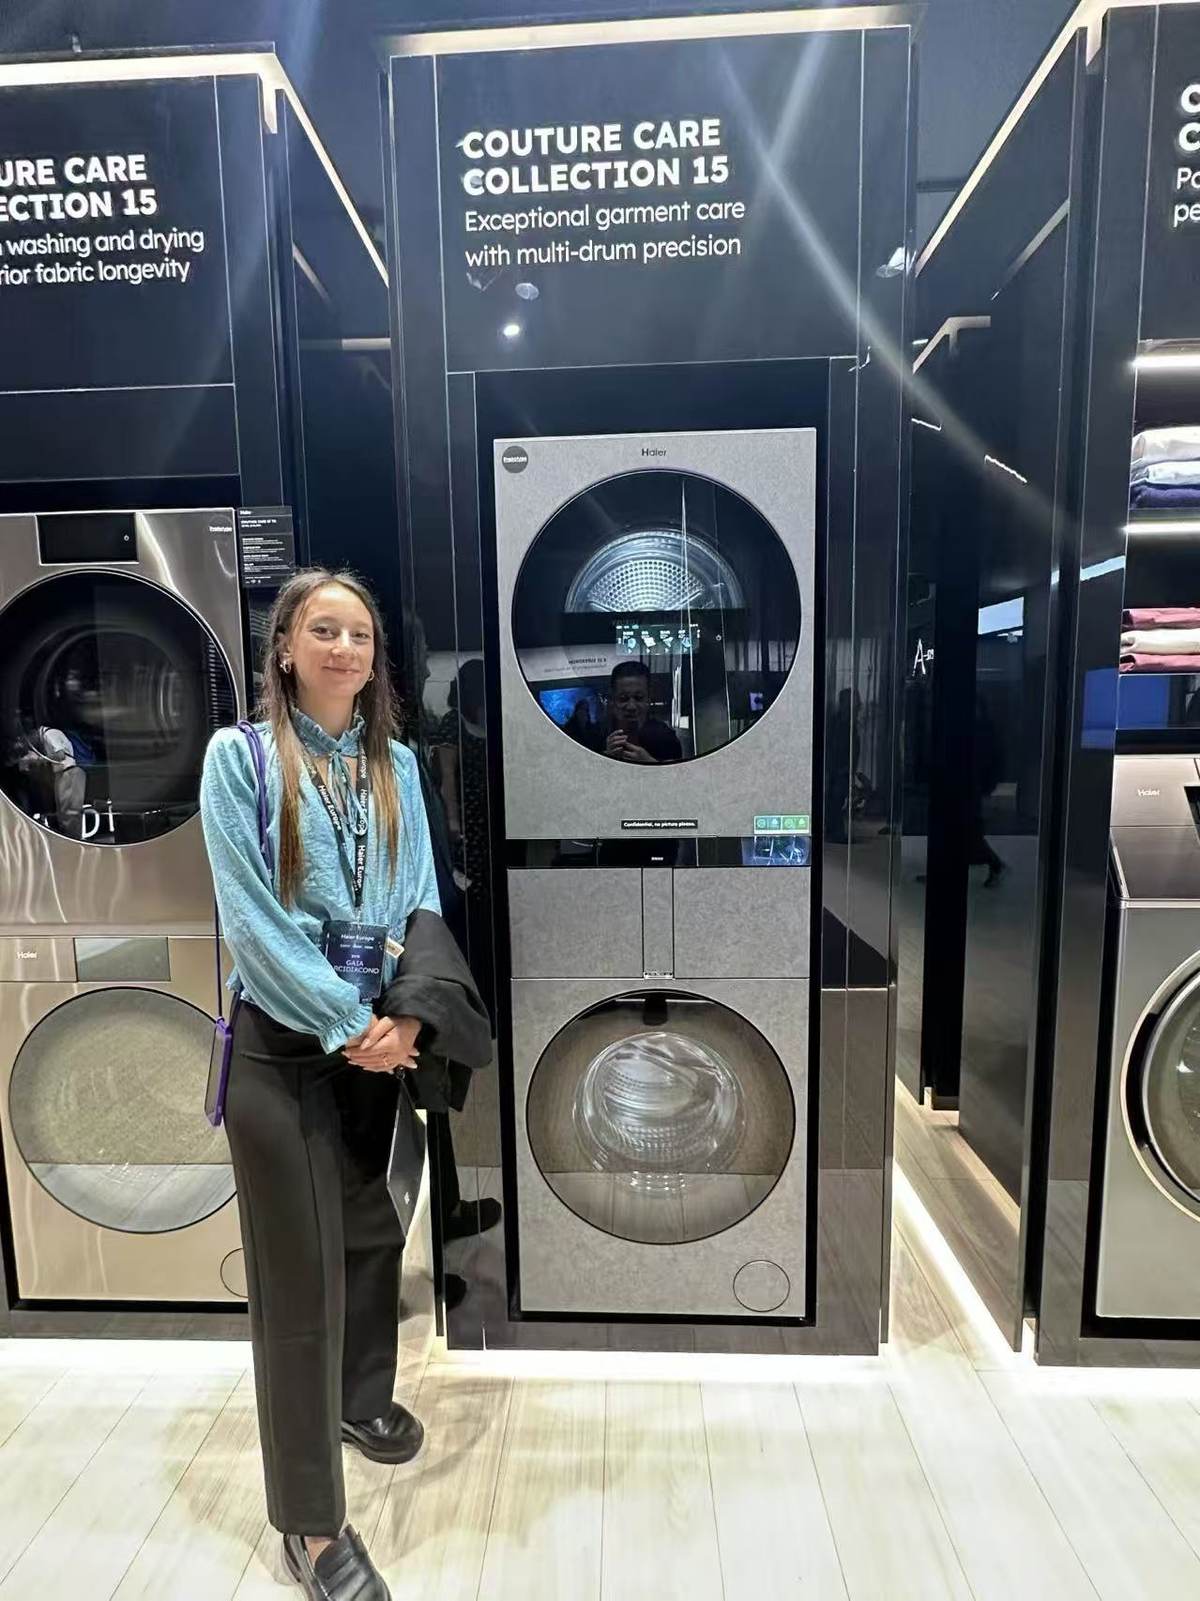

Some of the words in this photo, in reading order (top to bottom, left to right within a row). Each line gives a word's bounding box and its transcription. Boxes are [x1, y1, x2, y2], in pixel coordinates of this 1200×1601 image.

[462, 125, 622, 159] COUTURE
[633, 118, 721, 150] CARE
[64, 154, 147, 184] CARE
[463, 158, 680, 196] COLLECTION
[693, 155, 729, 184] 15
[121, 188, 158, 216] 15
[464, 204, 590, 235] Exceptional
[595, 201, 691, 231] garment
[696, 201, 745, 221] care
[6, 232, 91, 258] washing
[94, 229, 135, 252] and
[139, 227, 205, 254] drying
[465, 244, 510, 267] with
[517, 239, 637, 265] multi-drum
[643, 234, 742, 264] precision
[34, 260, 95, 284] fabric
[98, 257, 191, 285] longevity
[641, 447, 667, 457] Haier
[317, 784, 331, 804] Haier
[357, 844, 366, 865] Haier
[333, 965, 380, 974] RCIDIACONO
[345, 959, 364, 967] GAIA
